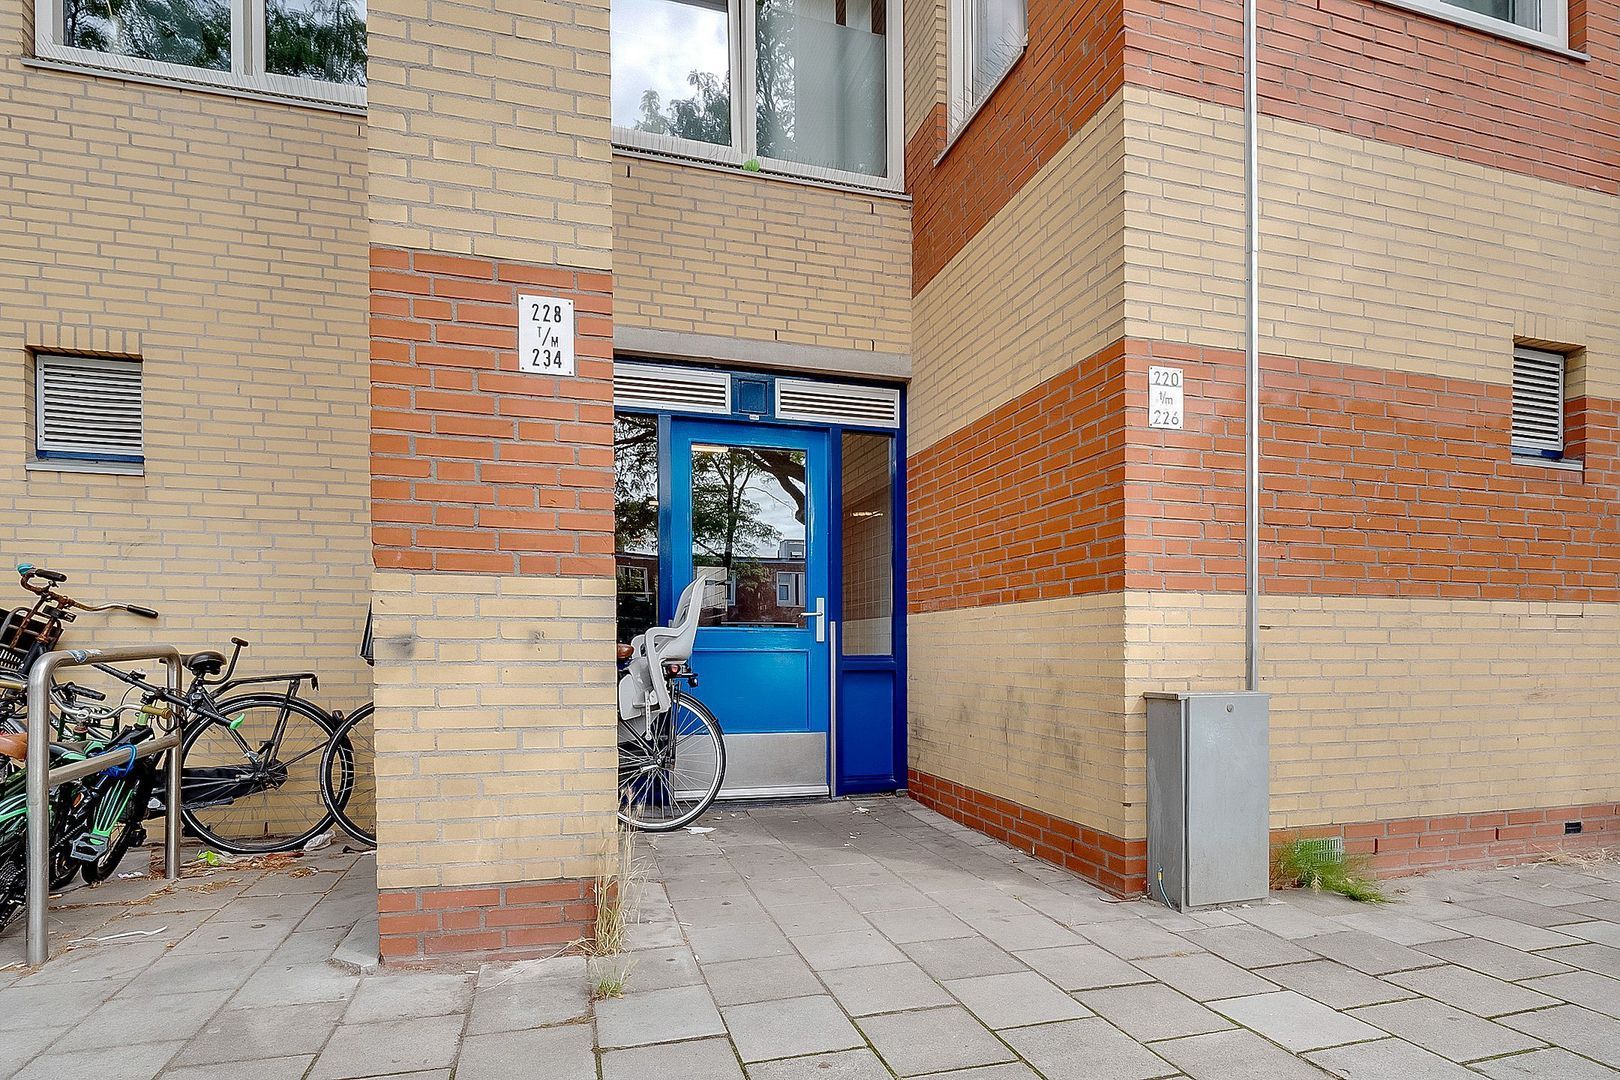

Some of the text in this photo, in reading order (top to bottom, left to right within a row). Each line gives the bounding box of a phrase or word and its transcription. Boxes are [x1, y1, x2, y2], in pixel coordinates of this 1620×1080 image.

[532, 303, 562, 323] 228
[532, 348, 562, 369] 234
[1153, 370, 1179, 387] 220
[1153, 409, 1180, 426] 226
